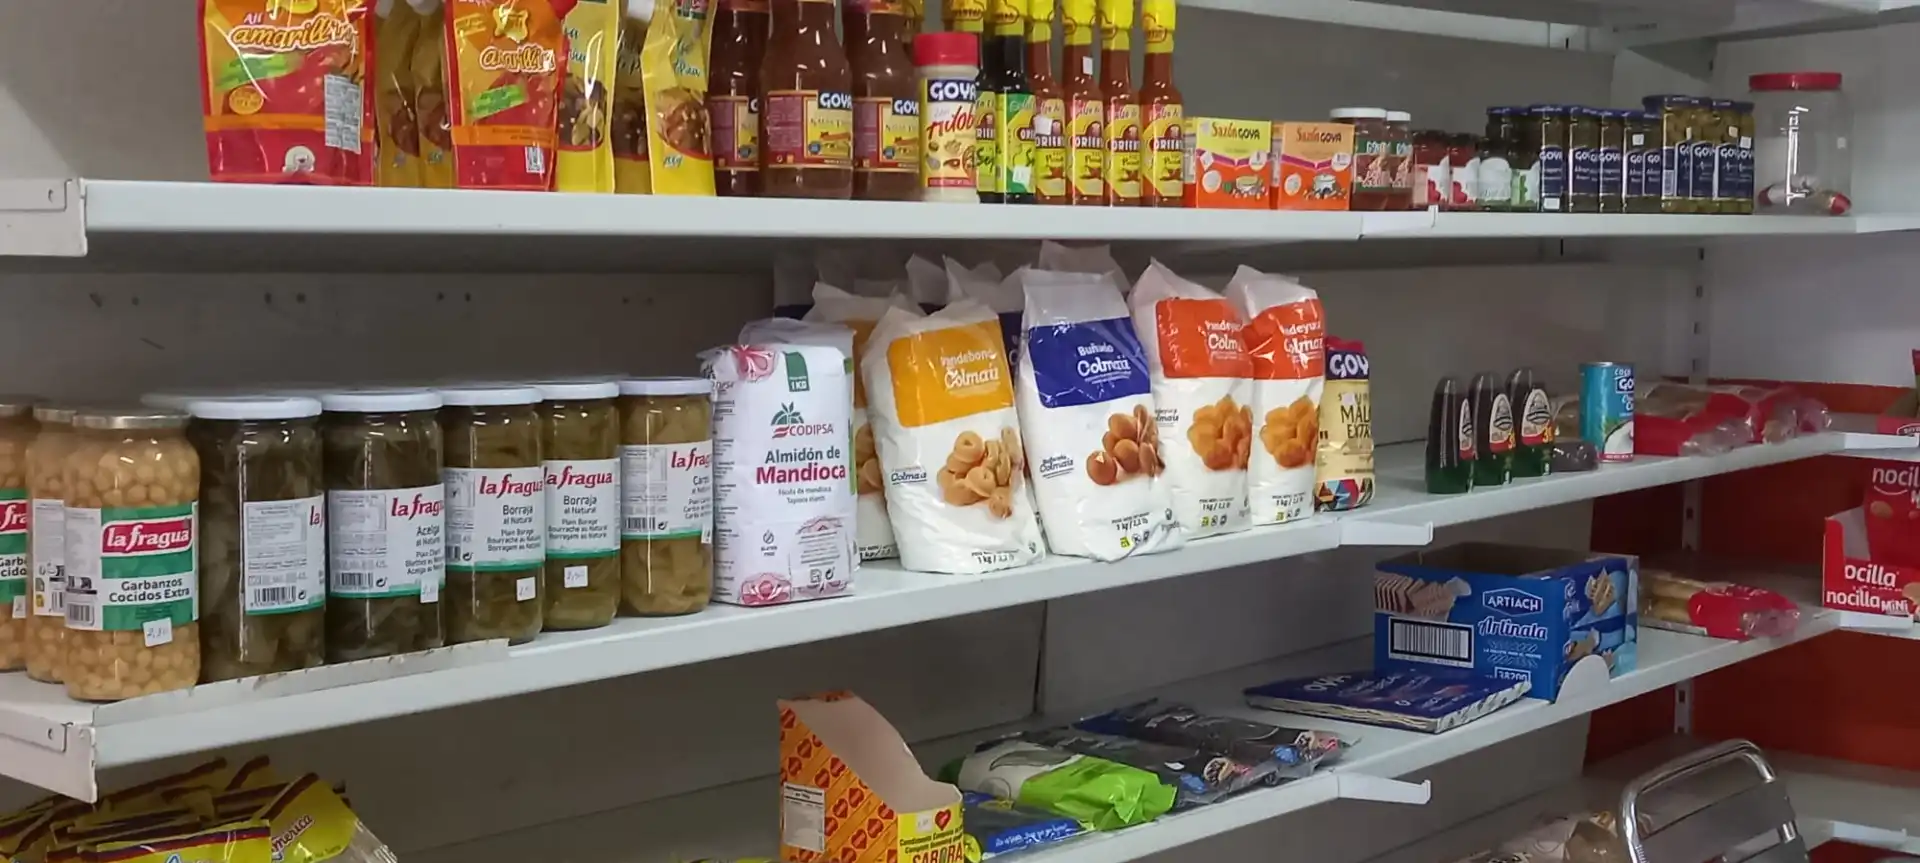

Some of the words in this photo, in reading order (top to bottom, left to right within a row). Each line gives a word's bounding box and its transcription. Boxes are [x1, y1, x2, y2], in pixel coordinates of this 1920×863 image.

[1238, 130, 1261, 141] GOYA
[1320, 132, 1342, 143] GOYA
[790, 424, 834, 437] CODIPSA
[765, 447, 823, 464] Almidón
[826, 446, 841, 459] de
[757, 462, 845, 485] Mandioca
[564, 495, 598, 506] Borraja
[121, 578, 183, 592] Garbanzos
[109, 591, 162, 603] Cocidos
[164, 587, 190, 599] Extra
[1826, 588, 1881, 608] nocilla
[1488, 595, 1539, 612] ARTIACH
